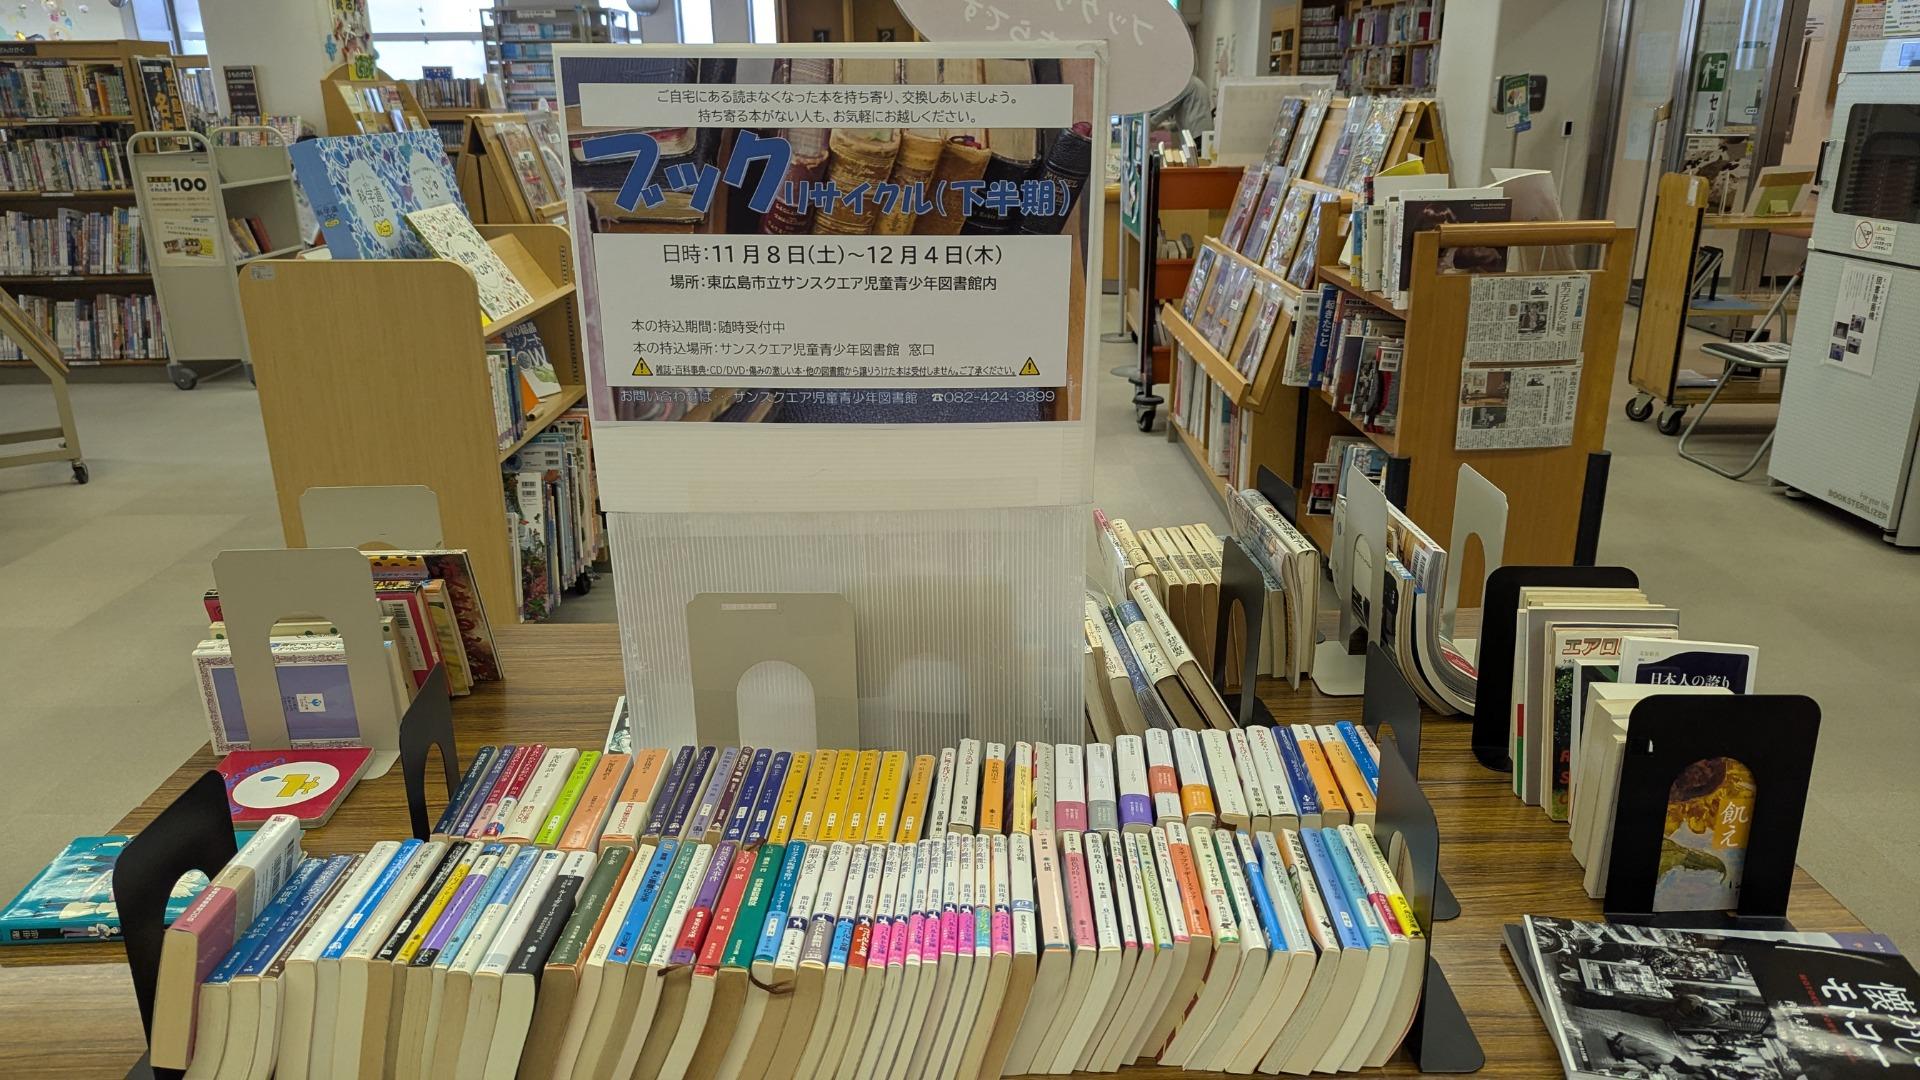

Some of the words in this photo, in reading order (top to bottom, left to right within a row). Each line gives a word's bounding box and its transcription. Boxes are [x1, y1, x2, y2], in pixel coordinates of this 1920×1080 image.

[657, 89, 1018, 106] ご自宅にある読まなくなった本を持ち寄り、交換しあいましょう。
[697, 108, 977, 124] 持ち寄る本がない人も、お気軽にお越しください。
[172, 177, 207, 192] 100
[669, 274, 998, 292] 場所：東広島市立サンスクエア児童青少年図書館内
[631, 319, 786, 335] 本の持込期間：随時受付中
[632, 341, 900, 357] 本の持込場所：サンスクエア児童青少年図書館
[908, 342, 936, 357] 窓口
[1561, 637, 1621, 656] エアロ
[1650, 671, 1731, 690] 日本人の誇り
[1720, 801, 1749, 847] 飢え
[1820, 977, 1891, 1068] モトコー
